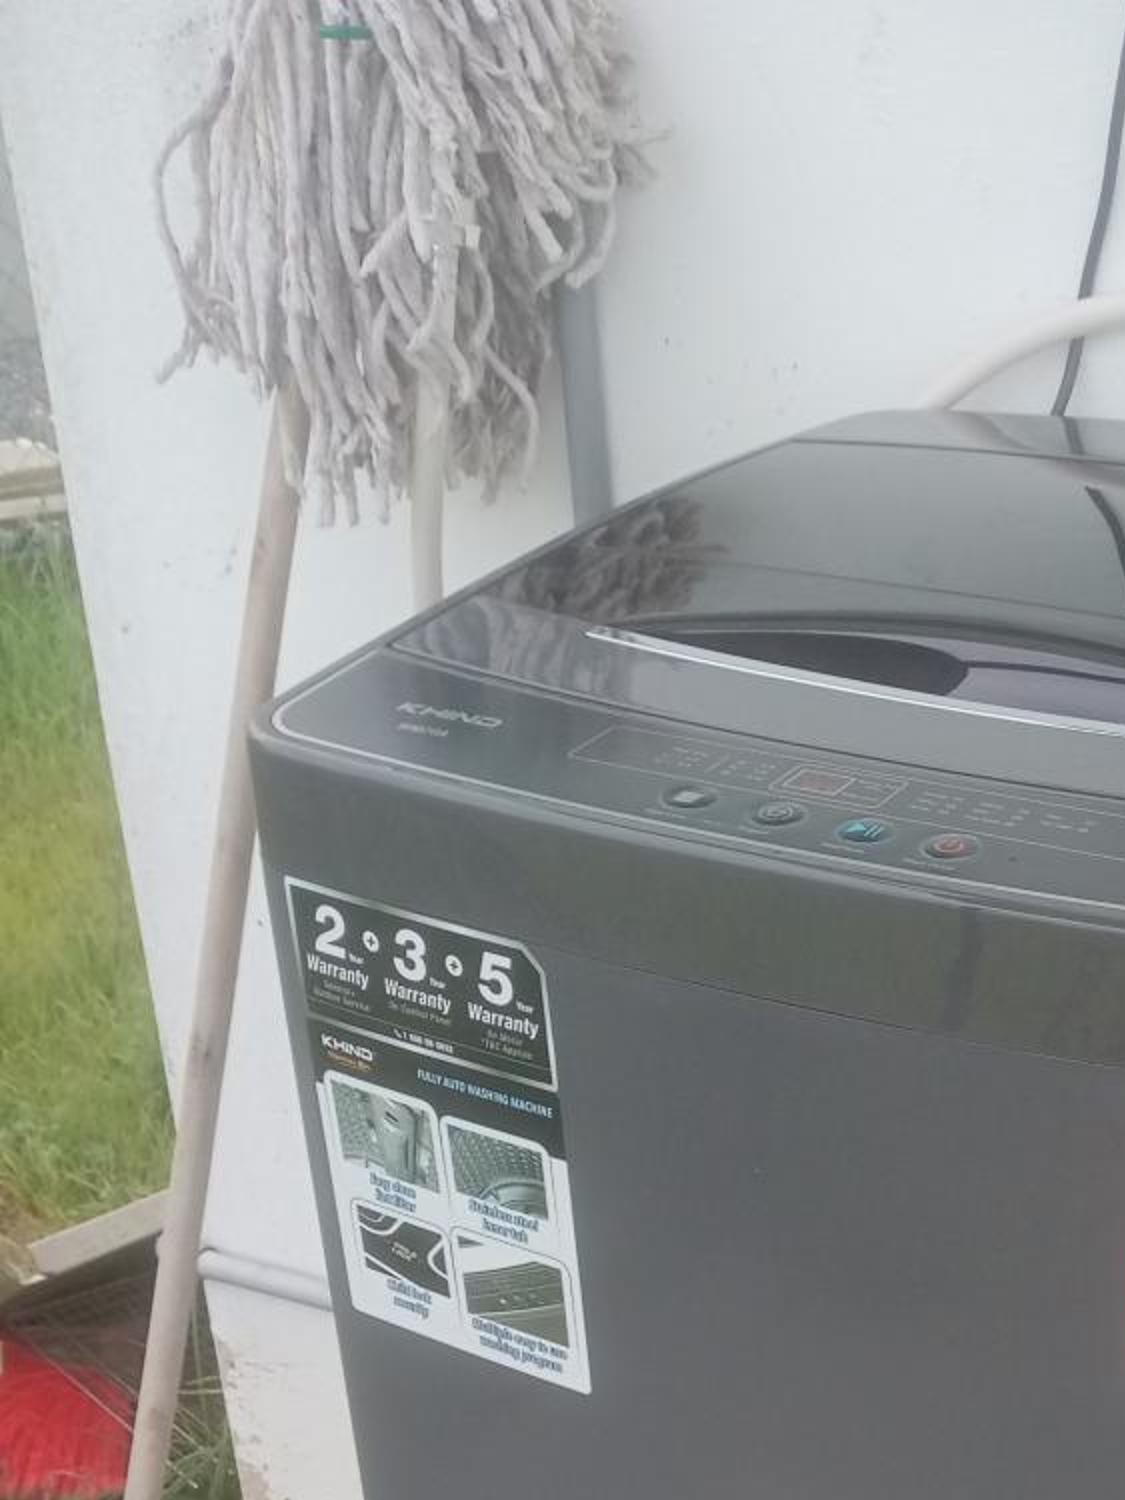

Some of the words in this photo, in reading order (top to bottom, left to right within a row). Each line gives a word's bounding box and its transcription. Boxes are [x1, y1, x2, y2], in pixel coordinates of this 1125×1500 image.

[315, 904, 346, 959] 2
[306, 952, 370, 991] Warranty
[393, 928, 427, 982] 3
[384, 977, 451, 1016] Warranty
[478, 951, 513, 1007] 5
[467, 1001, 539, 1041] Warranty
[320, 1033, 374, 1063] KHIND
[417, 1068, 442, 1087] FULLY
[443, 1074, 465, 1094] AUTO
[467, 1081, 509, 1106] WASHING
[510, 1093, 554, 1119] MACHINE
